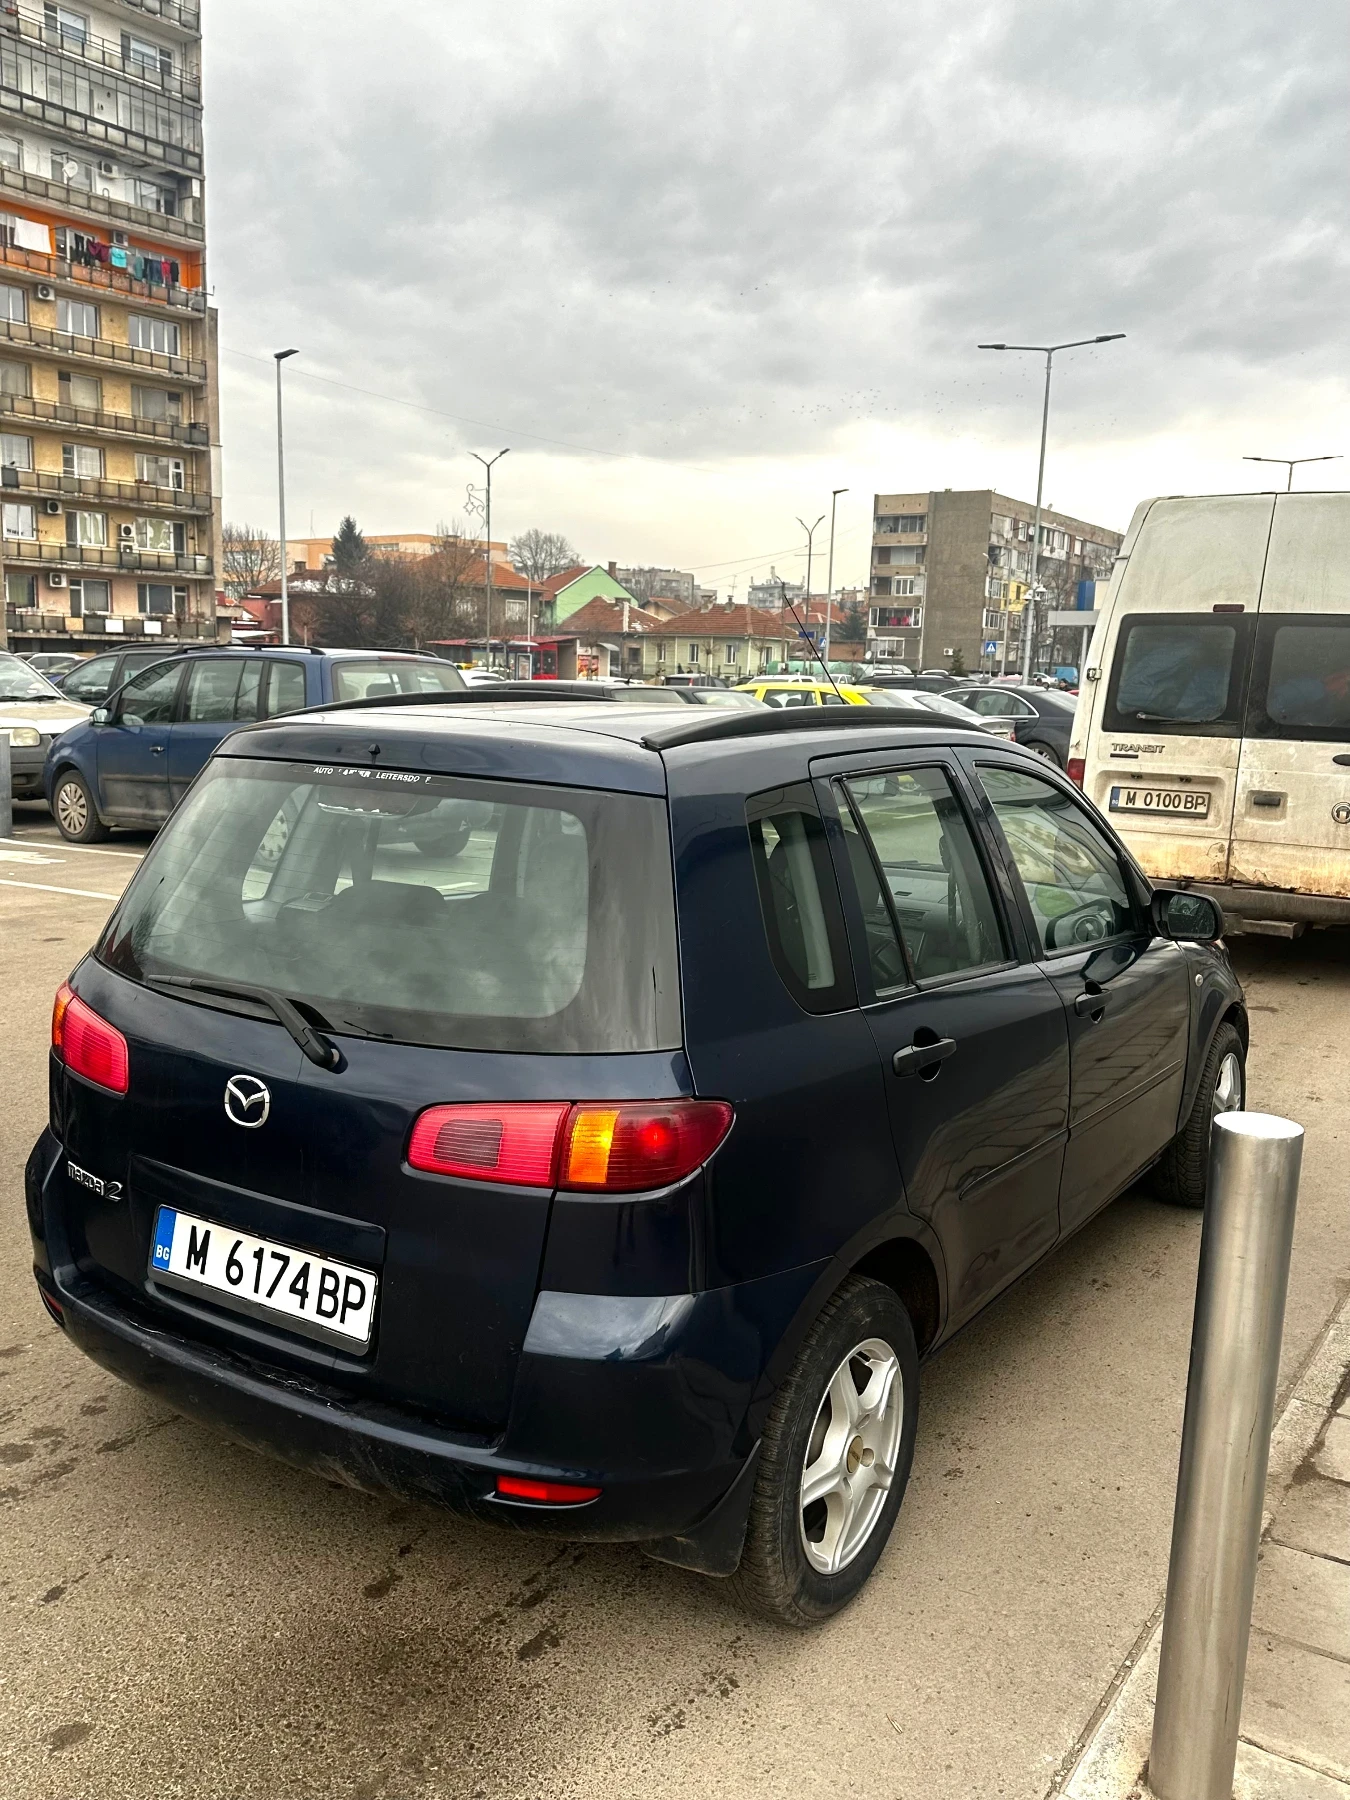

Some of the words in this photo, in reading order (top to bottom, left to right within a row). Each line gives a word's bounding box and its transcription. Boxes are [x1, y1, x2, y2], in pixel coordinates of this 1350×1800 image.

[1112, 742, 1166, 754] TRANSIT
[313, 766, 334, 775] AUTO
[1126, 791, 1136, 806] M
[155, 1244, 171, 1261] BG
[185, 1225, 212, 1275] M
